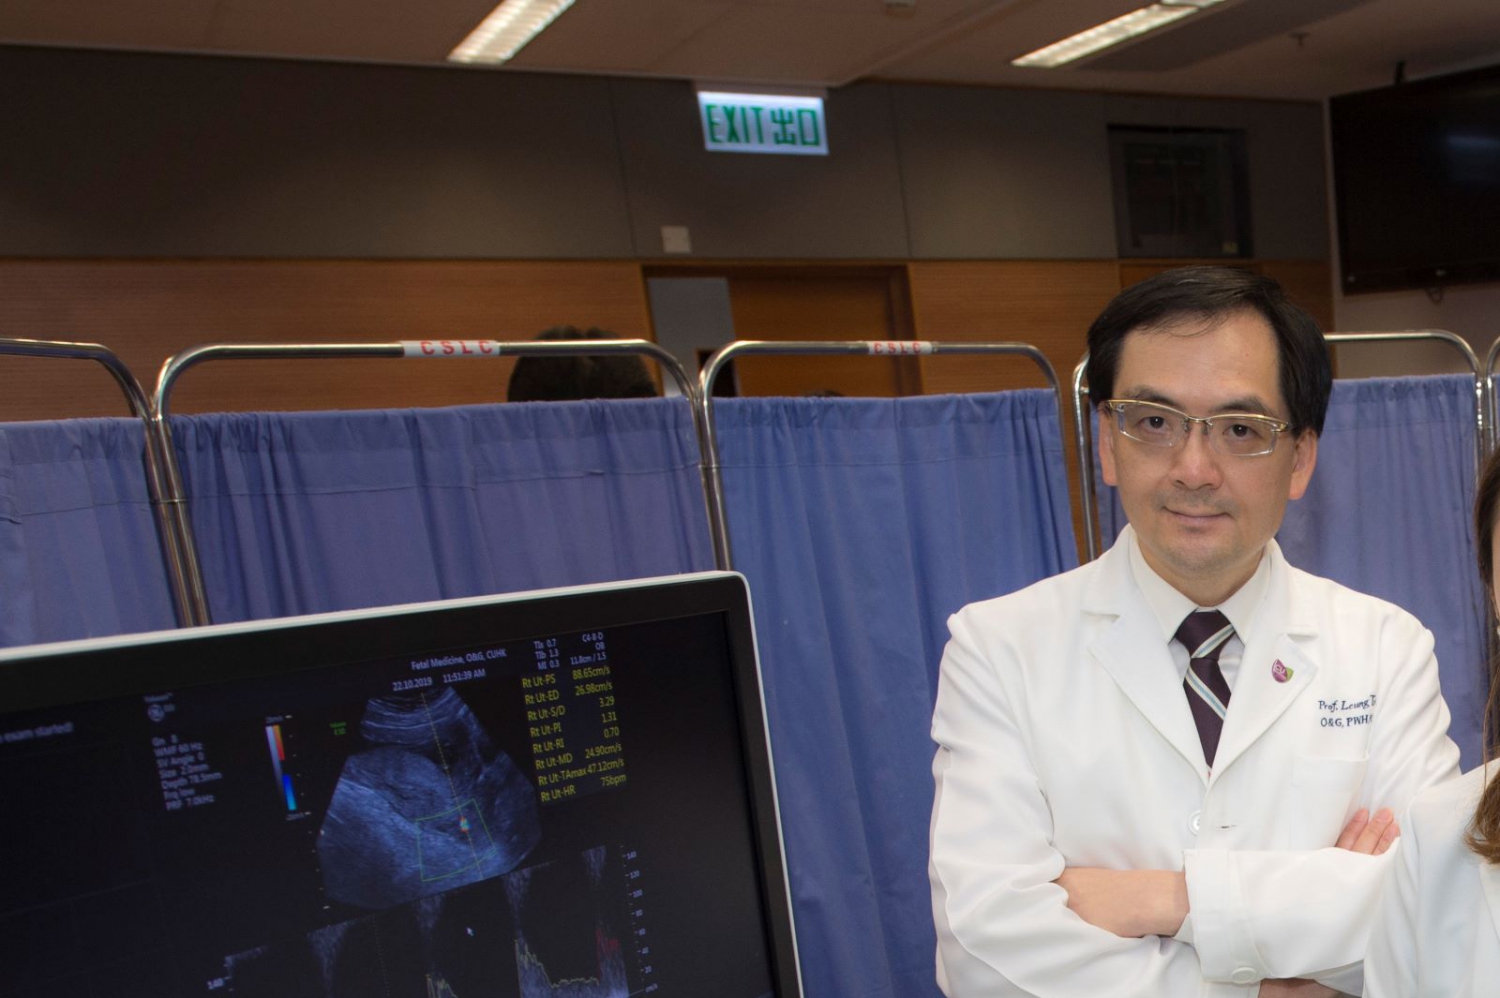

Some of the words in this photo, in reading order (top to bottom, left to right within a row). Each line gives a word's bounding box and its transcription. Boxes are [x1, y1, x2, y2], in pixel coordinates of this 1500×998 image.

[706, 104, 765, 144] EXIT
[770, 107, 821, 146] 出口
[420, 340, 493, 355] CSLC
[411, 660, 430, 670] Fetal
[431, 655, 465, 667] Medicine,
[486, 648, 508, 659] CUHK
[392, 676, 433, 691] 22.10.2019
[442, 670, 472, 684] 11:51:39
[473, 668, 486, 678] AM
[522, 678, 532, 689] Rt
[533, 673, 556, 687] Ut-PS
[572, 665, 611, 680] 88.65cm/s
[524, 694, 535, 705] Rt
[535, 689, 560, 703] Ut-ED
[575, 681, 613, 696] 26.98cm/s
[527, 710, 537, 721] Rt
[600, 695, 615, 707] 3.29
[1318, 700, 1339, 712] Prof.
[529, 726, 540, 738] Rt
[601, 711, 617, 723] 1.31
[1320, 716, 1345, 728] O&G,
[532, 743, 542, 754] Rt
[603, 726, 620, 738] 0.70
[535, 760, 545, 770] Rt
[546, 753, 573, 767] Ut-MD
[585, 743, 622, 759] 24.90cm/s
[538, 775, 548, 786] Rt
[548, 767, 587, 784] Ut-TAmax
[587, 758, 625, 774] 47.12cm/s
[540, 791, 551, 802] Rt
[551, 785, 576, 800] Ut-HR
[600, 774, 627, 787] 75bpm
